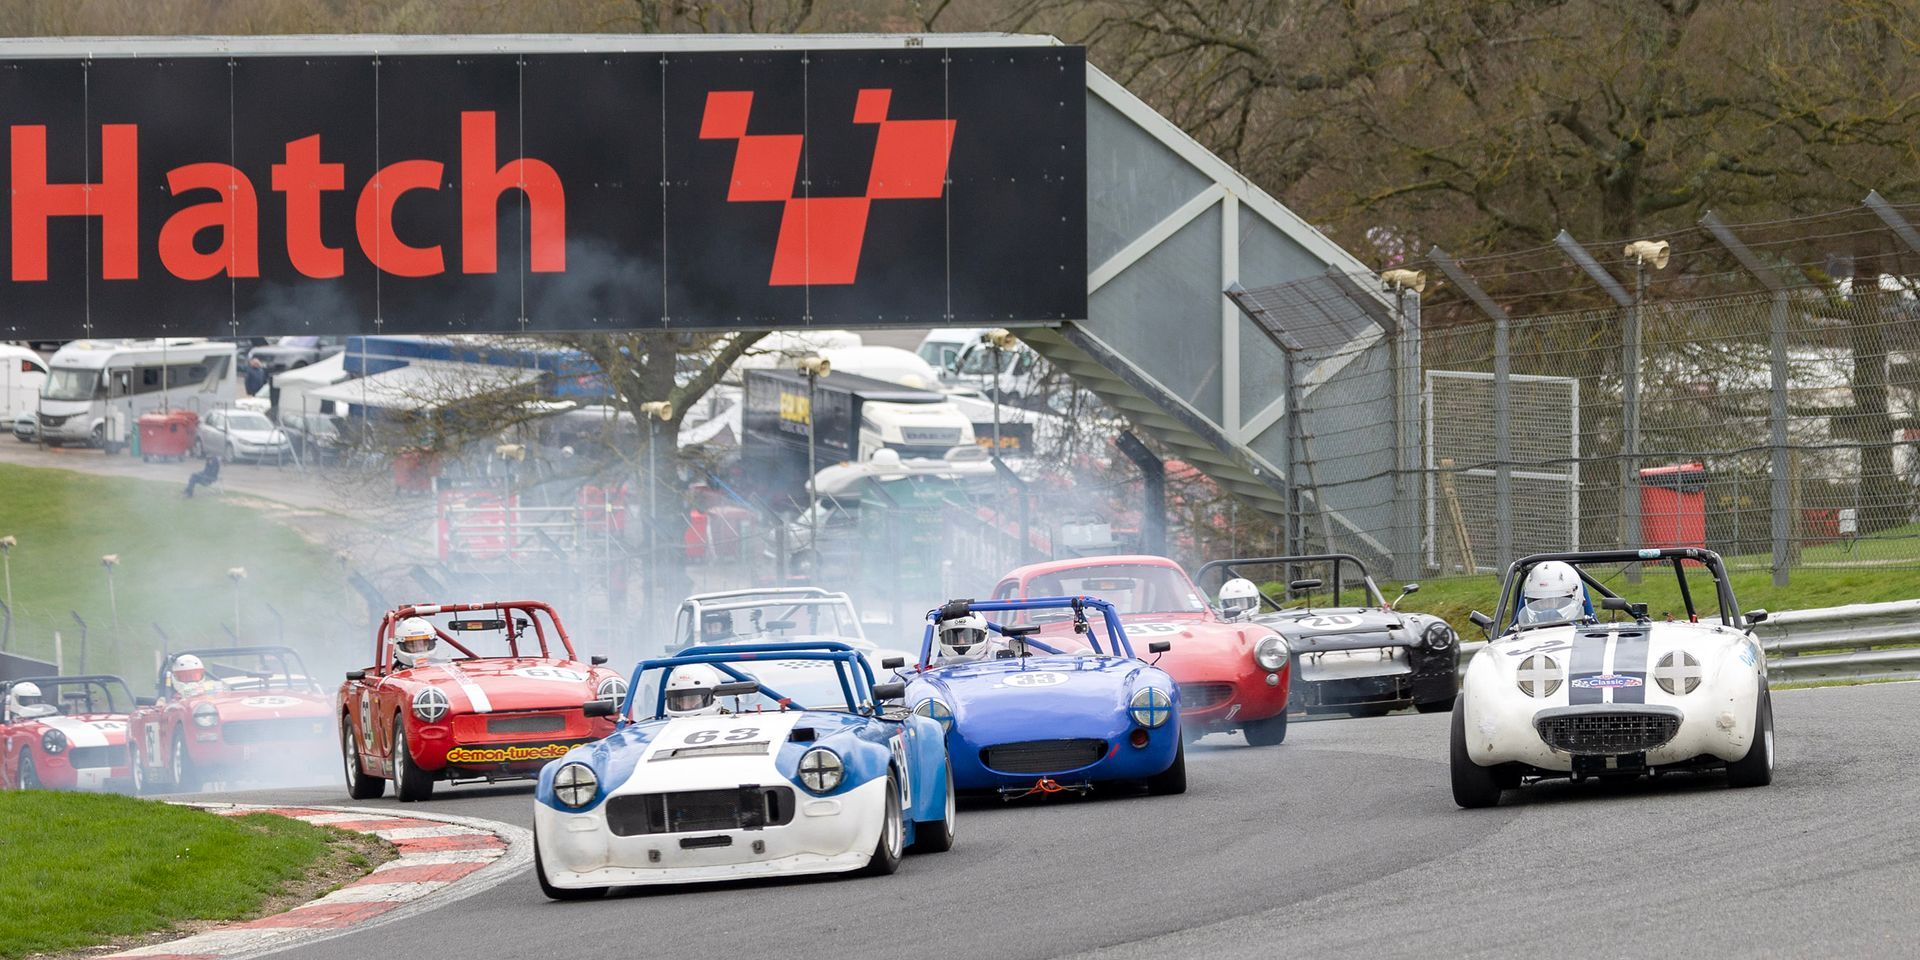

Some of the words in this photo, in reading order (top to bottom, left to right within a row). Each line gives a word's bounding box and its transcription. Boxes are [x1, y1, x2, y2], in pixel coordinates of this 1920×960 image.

[11, 111, 566, 281] Hatch
[1303, 615, 1353, 627] 20
[1015, 673, 1057, 685] 33
[683, 727, 761, 744] 63
[447, 744, 584, 762] demon-tweeks
